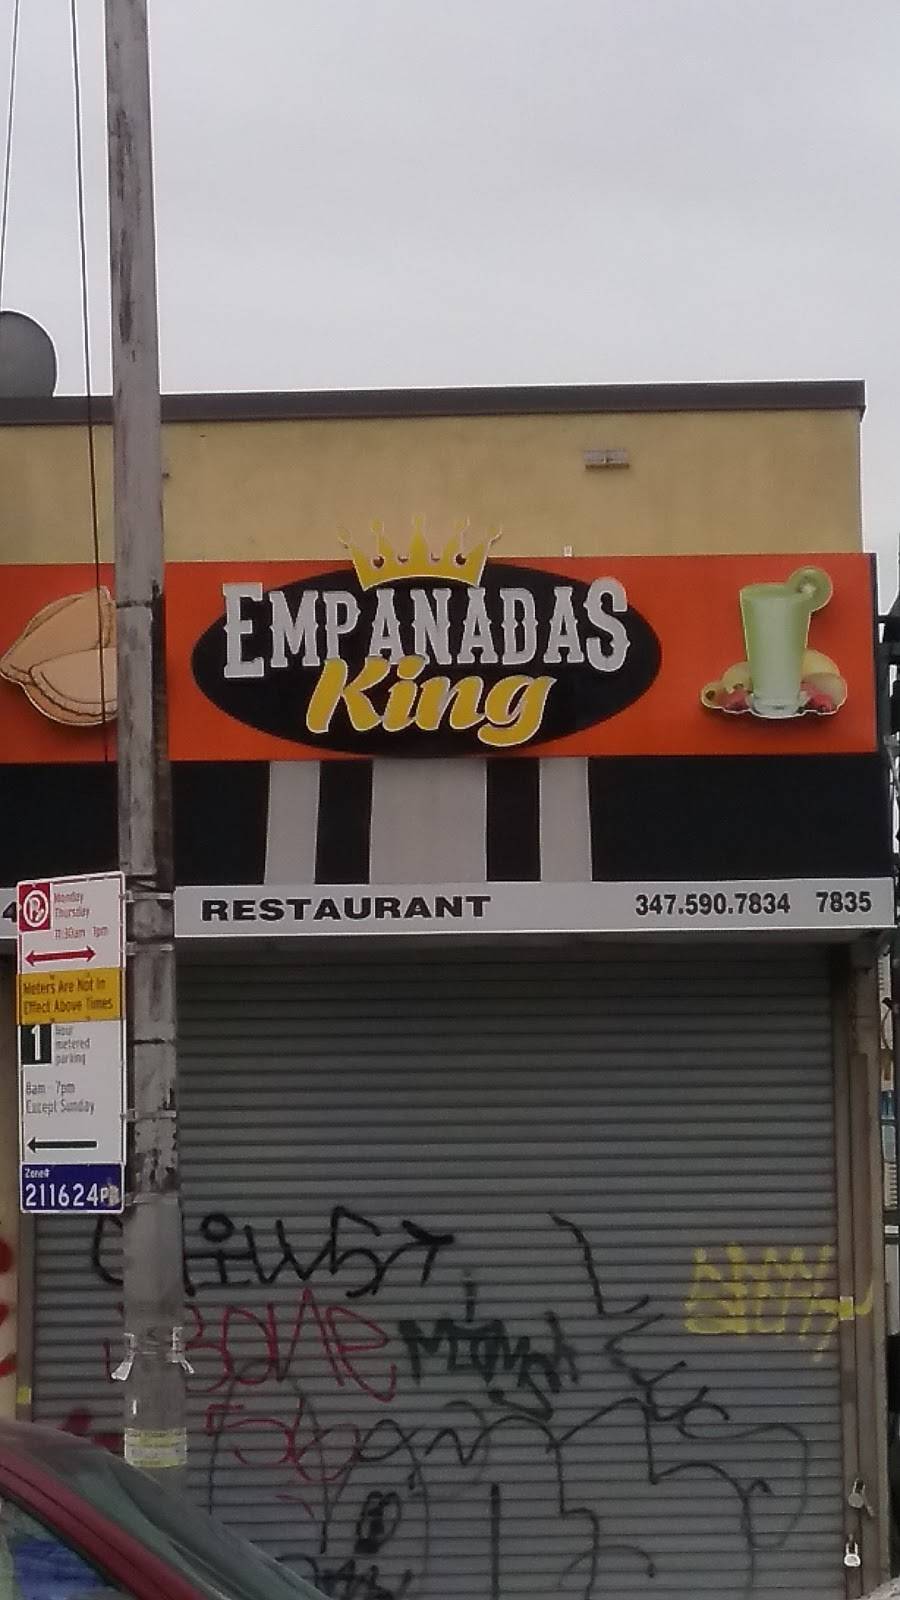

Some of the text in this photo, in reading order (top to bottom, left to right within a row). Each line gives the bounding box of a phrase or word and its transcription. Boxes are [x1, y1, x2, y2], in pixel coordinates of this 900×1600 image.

[222, 576, 631, 679] EMPANADAS
[306, 654, 557, 747] King
[202, 896, 491, 921] RESTAURANT
[635, 891, 872, 915] 347.590.7834 7835
[23, 983, 56, 995] Meters
[58, 981, 75, 993] Are
[54, 999, 83, 1013] Above
[31, 1024, 41, 1061] 1
